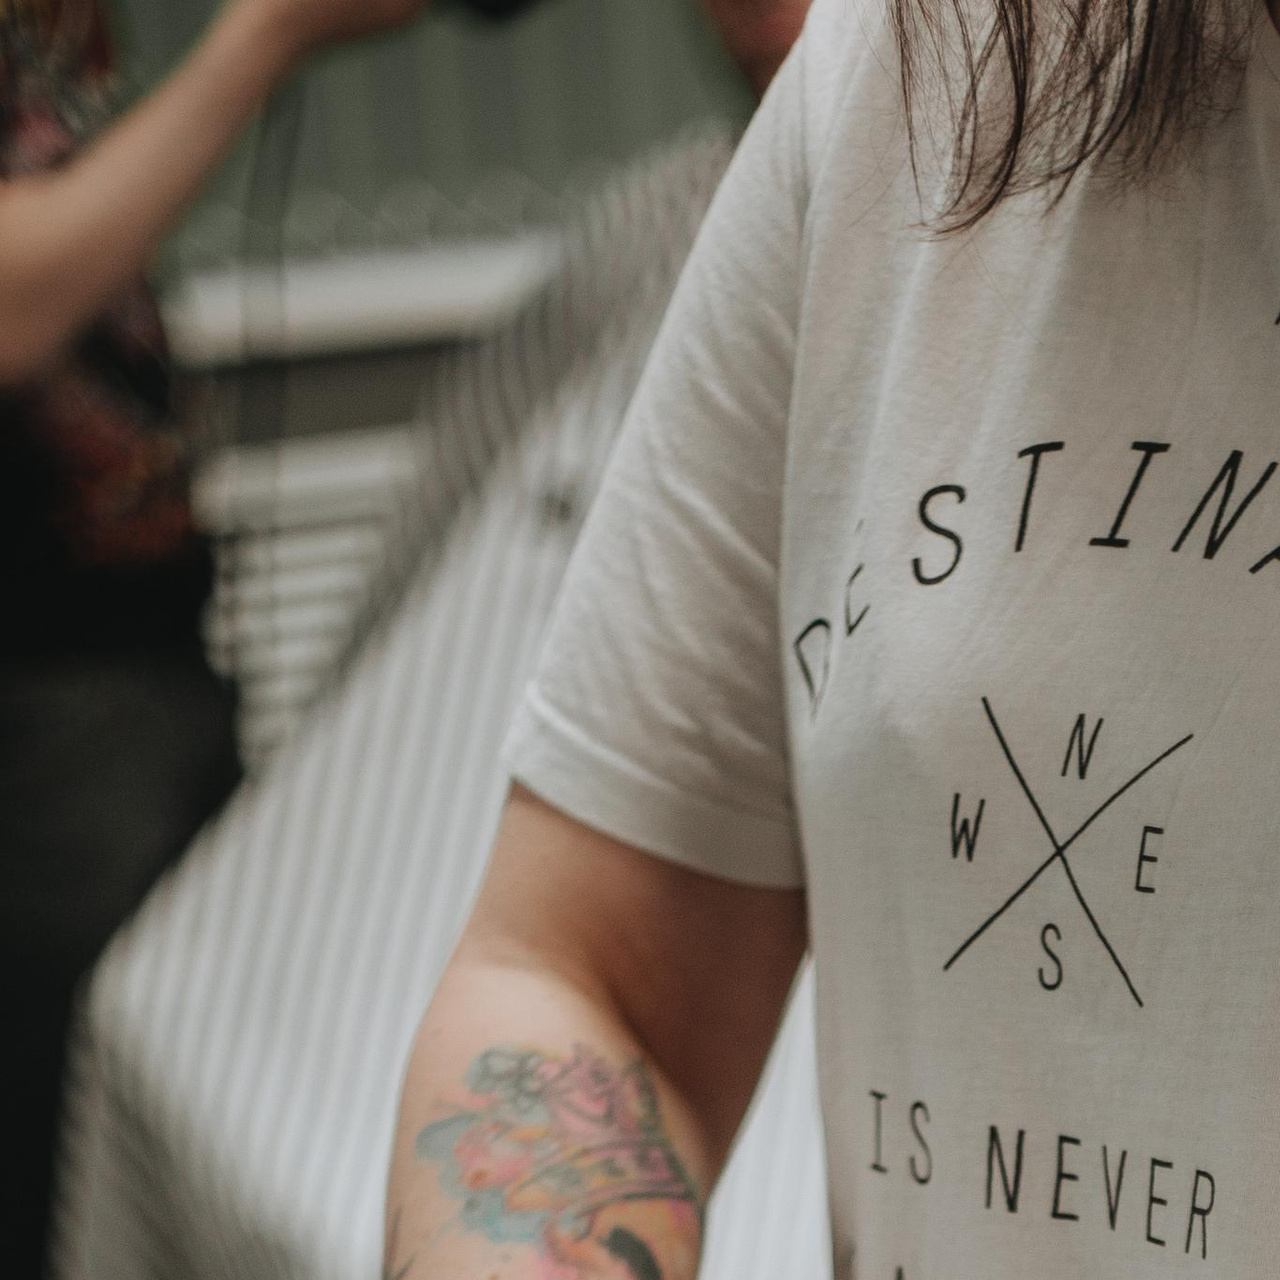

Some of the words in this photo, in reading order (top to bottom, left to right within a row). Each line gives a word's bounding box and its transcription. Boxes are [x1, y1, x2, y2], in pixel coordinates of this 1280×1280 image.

[1061, 713, 1104, 780] N
[951, 792, 986, 863] W
[1135, 824, 1165, 894] E
[1038, 922, 1064, 991] S
[868, 1089, 933, 1186] IS
[984, 1124, 1216, 1260] NEVER
